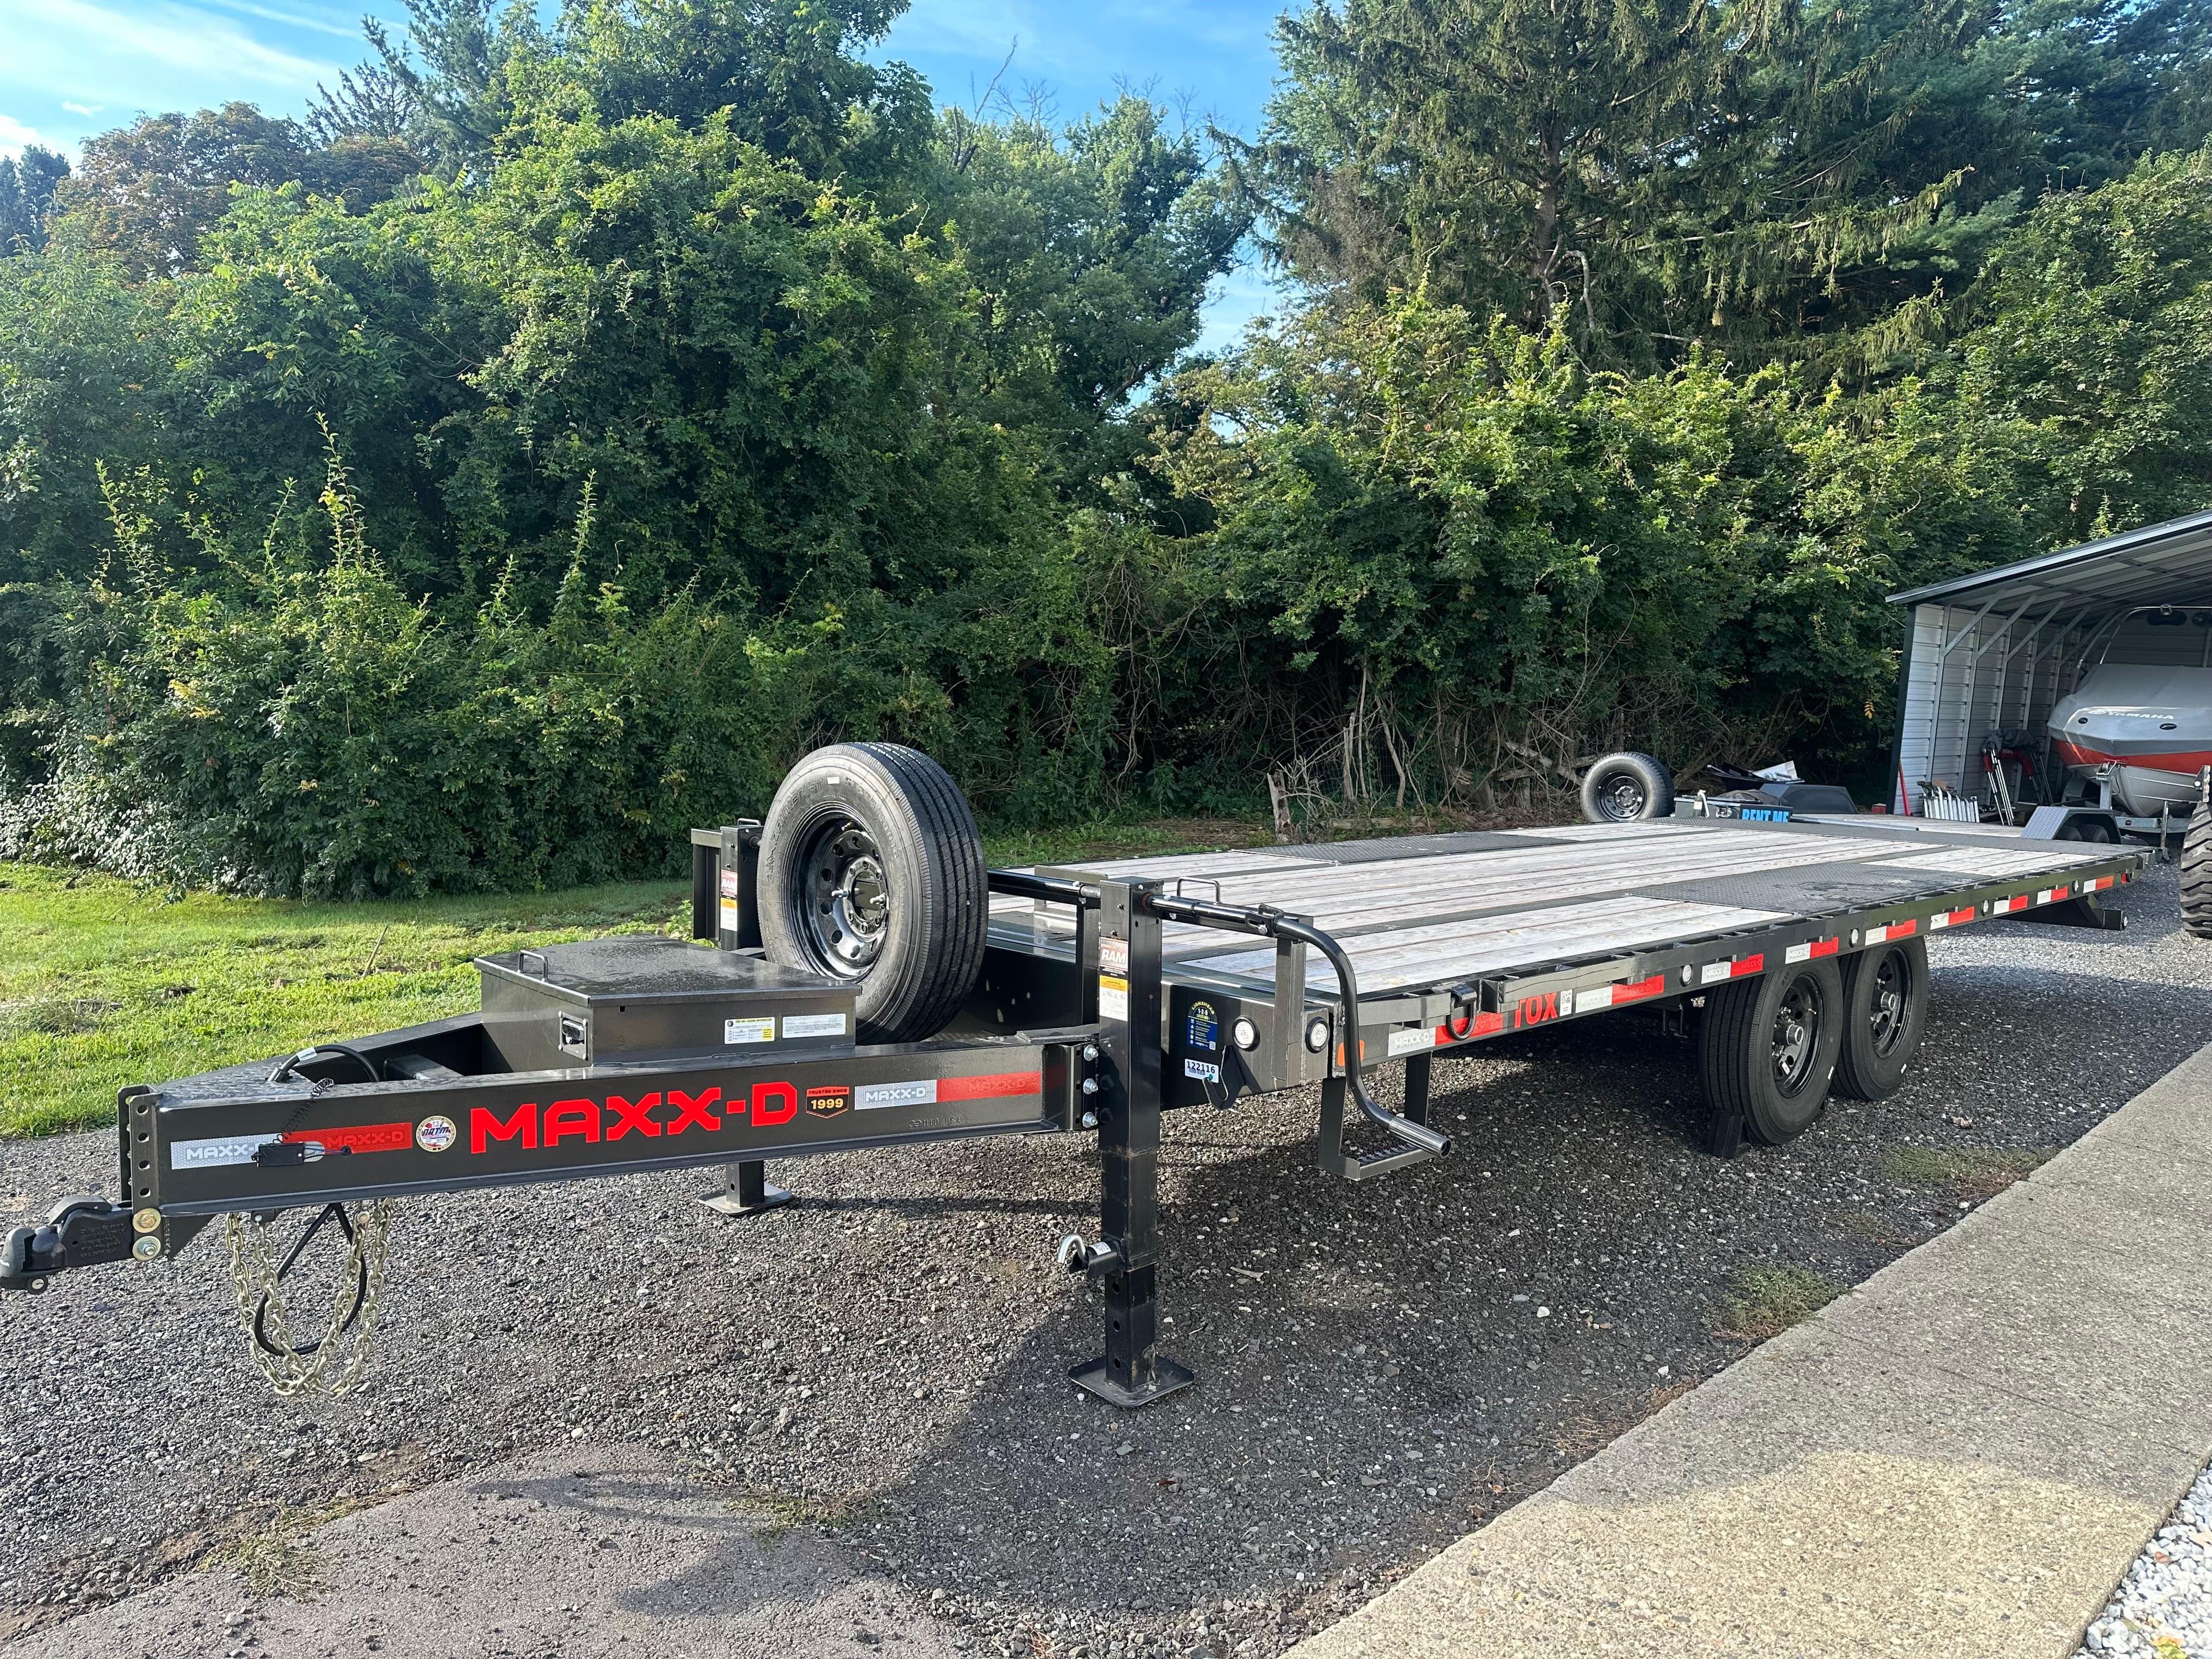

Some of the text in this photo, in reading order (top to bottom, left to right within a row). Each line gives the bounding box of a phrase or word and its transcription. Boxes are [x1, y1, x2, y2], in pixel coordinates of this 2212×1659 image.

[2108, 710, 2174, 719] YAMAHA
[1772, 810, 1789, 823] ME
[1101, 948, 1127, 964] RAM
[1789, 948, 1808, 959] MAXX-D
[1706, 967, 1728, 978] MAXX-D
[1191, 1001, 1215, 1015] LIONSHEAD
[1394, 1031, 1430, 1048] MAXX-D
[1187, 1061, 1215, 1074] 122116
[967, 1078, 1028, 1093] MAXX-D
[866, 1087, 926, 1102] MAXX-D
[811, 1098, 843, 1109] 1999
[471, 1081, 798, 1154] MAXX-D
[327, 1131, 404, 1147] MAXX-D
[187, 1143, 260, 1160] MAXX-
